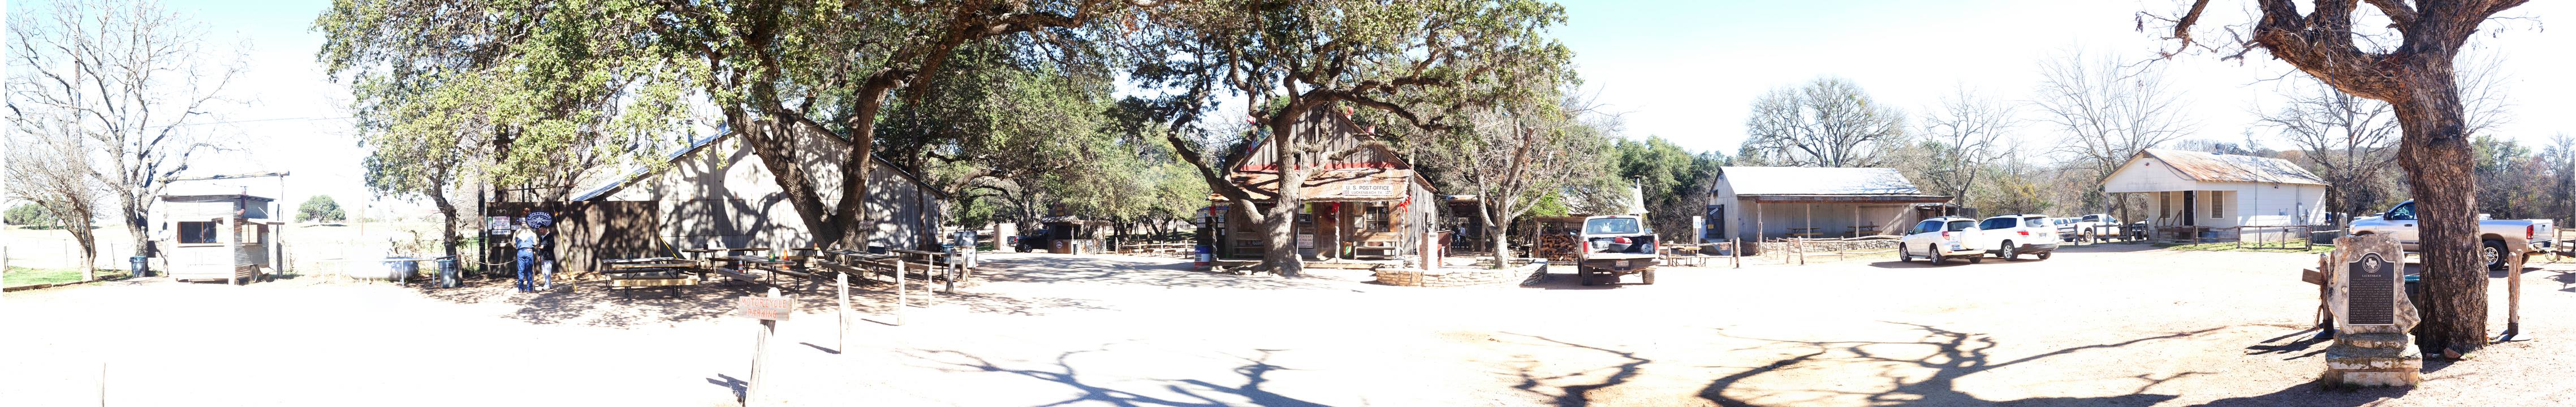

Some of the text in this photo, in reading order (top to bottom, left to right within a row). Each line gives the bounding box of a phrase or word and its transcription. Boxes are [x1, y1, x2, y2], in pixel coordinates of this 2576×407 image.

[527, 211, 552, 220] LUCKENBACH
[741, 298, 786, 308] MOTORCYCLE
[747, 308, 778, 319] PARKING
